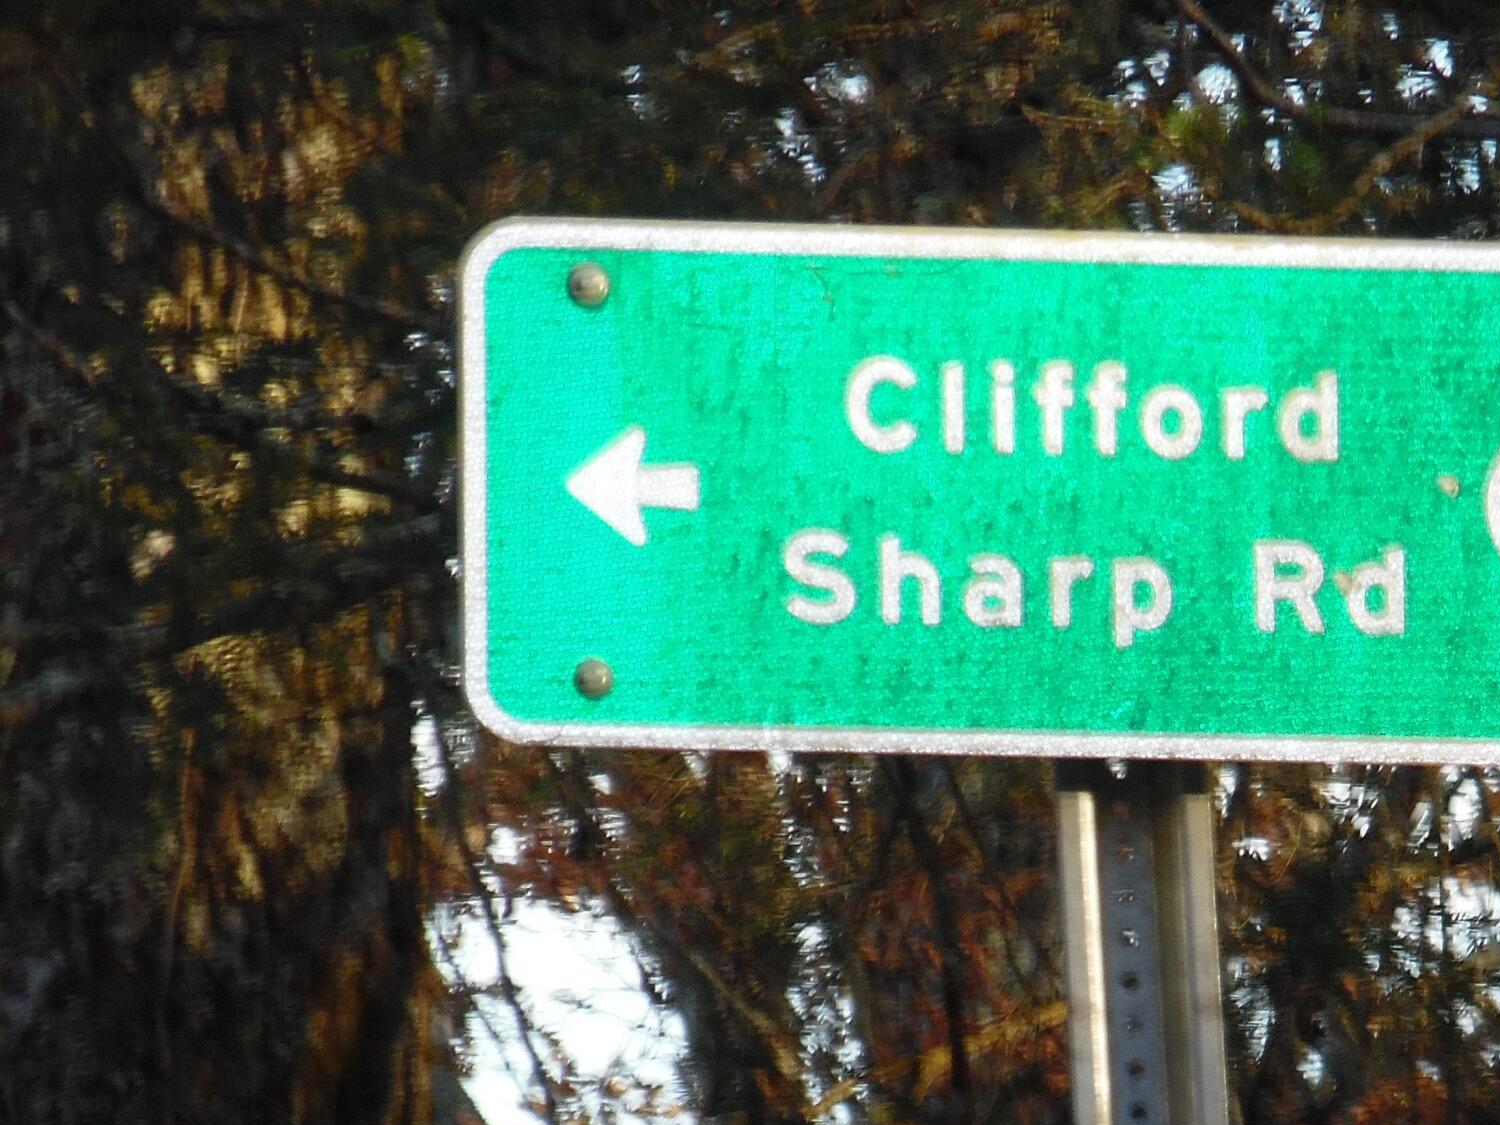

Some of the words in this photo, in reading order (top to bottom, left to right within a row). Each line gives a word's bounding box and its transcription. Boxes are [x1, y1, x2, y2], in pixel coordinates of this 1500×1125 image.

[844, 354, 1342, 463] Clifford
[781, 528, 1174, 648] Sharp
[1251, 538, 1408, 638] Rd
